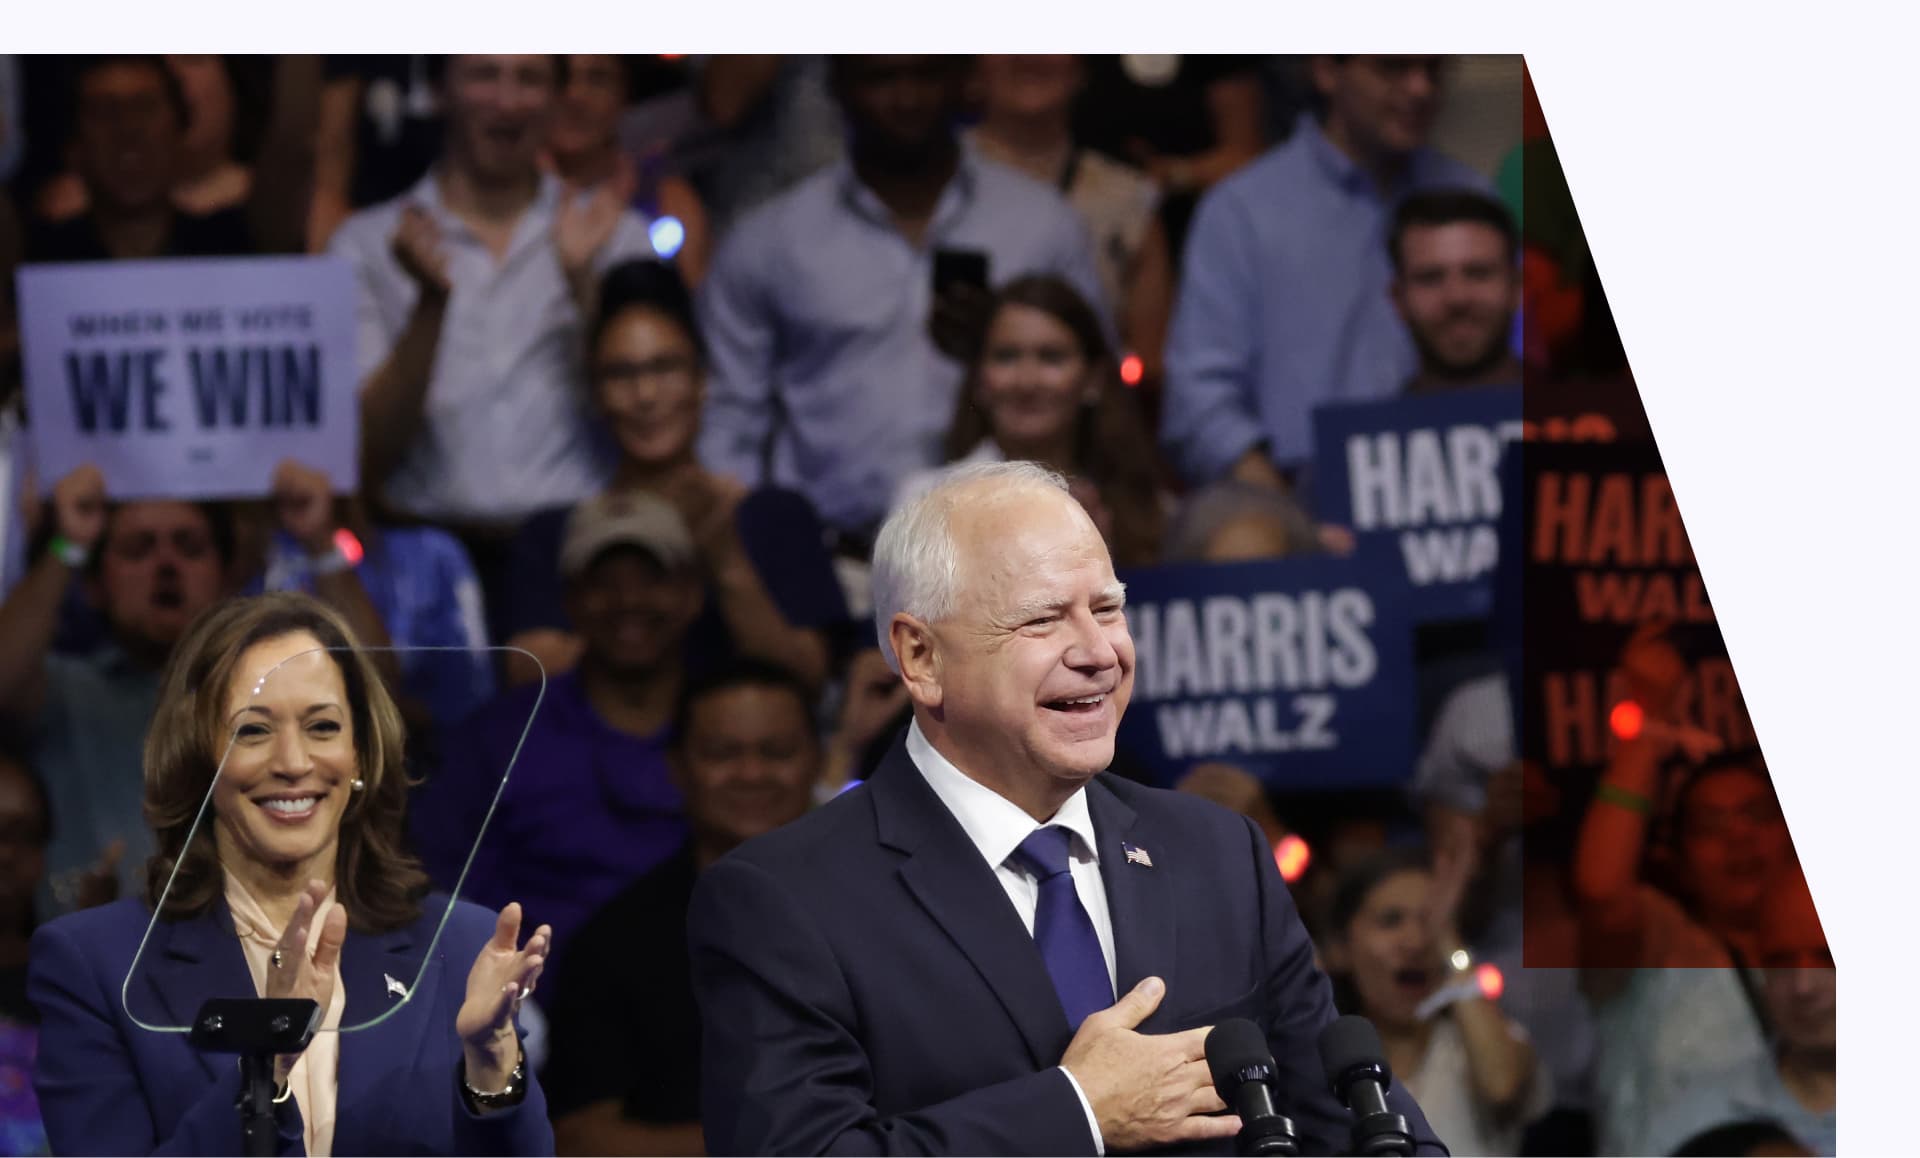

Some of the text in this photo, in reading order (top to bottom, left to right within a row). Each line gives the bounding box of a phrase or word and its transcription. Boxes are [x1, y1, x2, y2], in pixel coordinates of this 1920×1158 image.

[68, 313, 167, 338] WHEN
[180, 307, 225, 333] WE
[65, 342, 323, 434] WE WIN
[1347, 414, 1616, 530] HAR
[1127, 586, 1377, 699] HARRIS
[1156, 694, 1337, 759] WALZ
